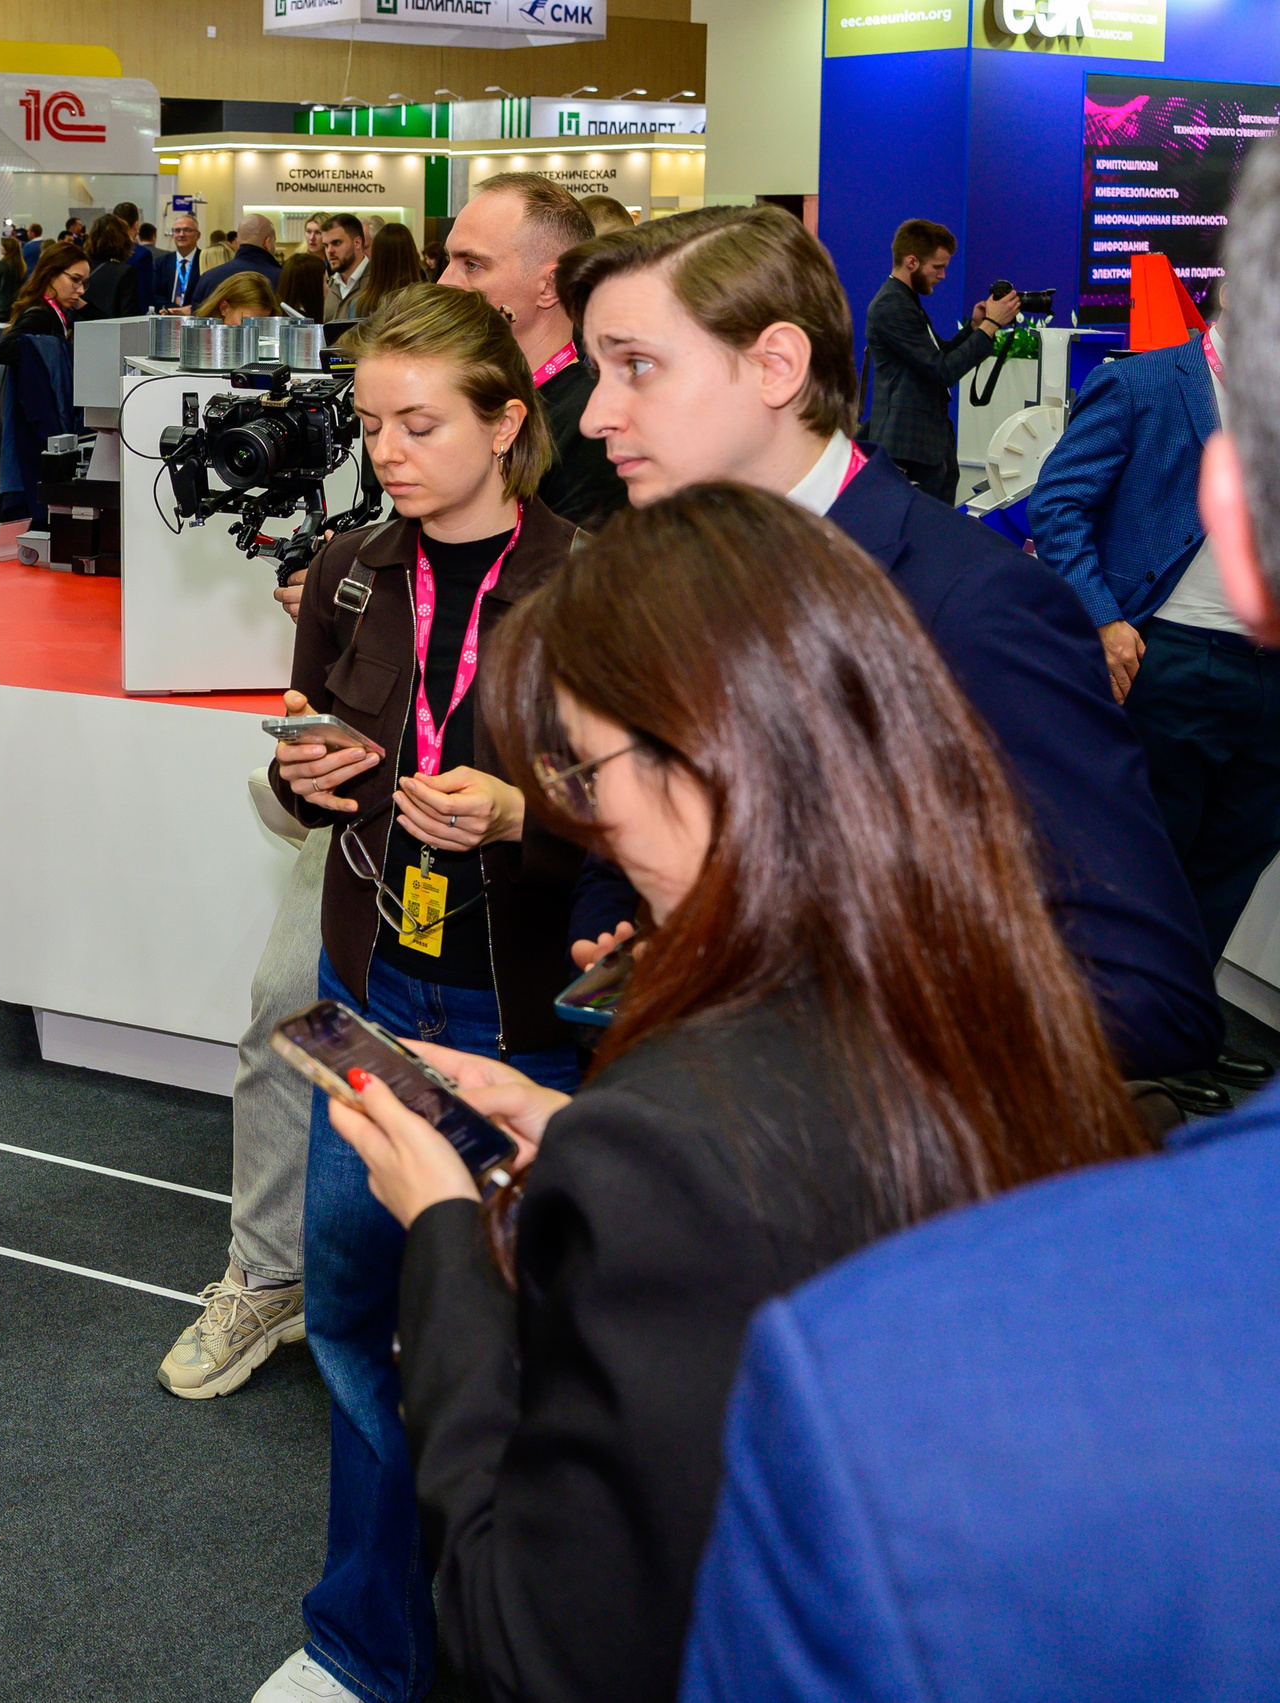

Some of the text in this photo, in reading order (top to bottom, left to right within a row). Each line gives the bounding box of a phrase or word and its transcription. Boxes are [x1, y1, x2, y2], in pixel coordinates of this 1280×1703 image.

[550, 4, 593, 25] СМК
[840, 9, 952, 28] eec.eaeunion.org
[1096, 159, 1158, 171] КРИПТОШЛЮЗЫ
[289, 169, 373, 179] СТРОИТЕЛЬНАЯ
[276, 182, 386, 193] ПРОМЫШЛЕННОСТЬ
[1095, 187, 1179, 198] КИБЕРБЕЗОПАСНОСТЬ
[1094, 214, 1228, 226] ИНФОРМАЦИОННАЯ БЕЗОПАСНОСТЬ
[1093, 241, 1149, 252] ШИФРОВАНИЕ
[1191, 268, 1225, 279] ПОДПИСЬ
